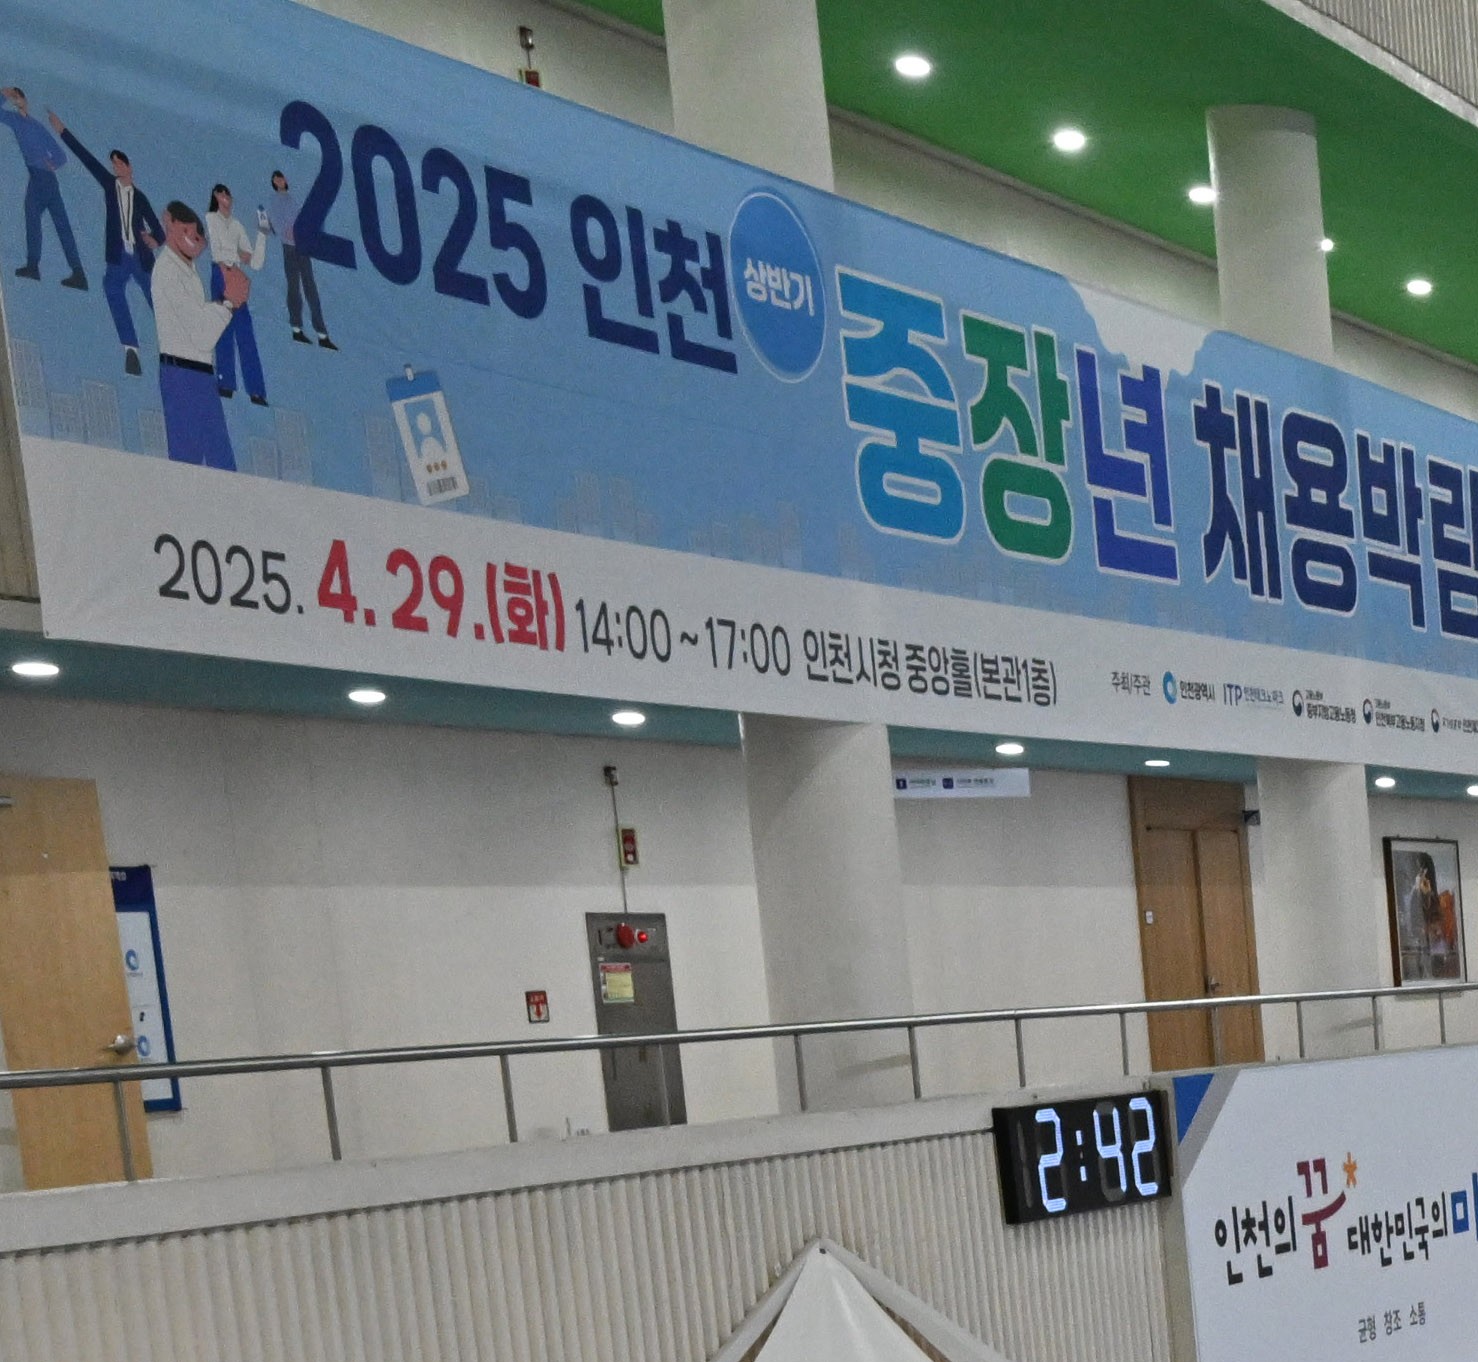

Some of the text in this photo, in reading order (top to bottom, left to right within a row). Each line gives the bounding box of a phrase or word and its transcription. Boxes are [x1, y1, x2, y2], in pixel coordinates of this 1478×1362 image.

[280, 100, 546, 320] 2025
[569, 194, 738, 375] 인천
[743, 249, 817, 319] 상반기
[835, 266, 1180, 585] 중장년
[154, 533, 304, 616] 2025.
[803, 628, 901, 694] 인천시청
[1035, 1097, 1159, 1213] 2:42
[1215, 1157, 1347, 1286] 인천의 꿈
[1347, 1192, 1448, 1268] 대한민국의
[1358, 1314, 1377, 1344] 균형
[1409, 1302, 1427, 1327] 소통
